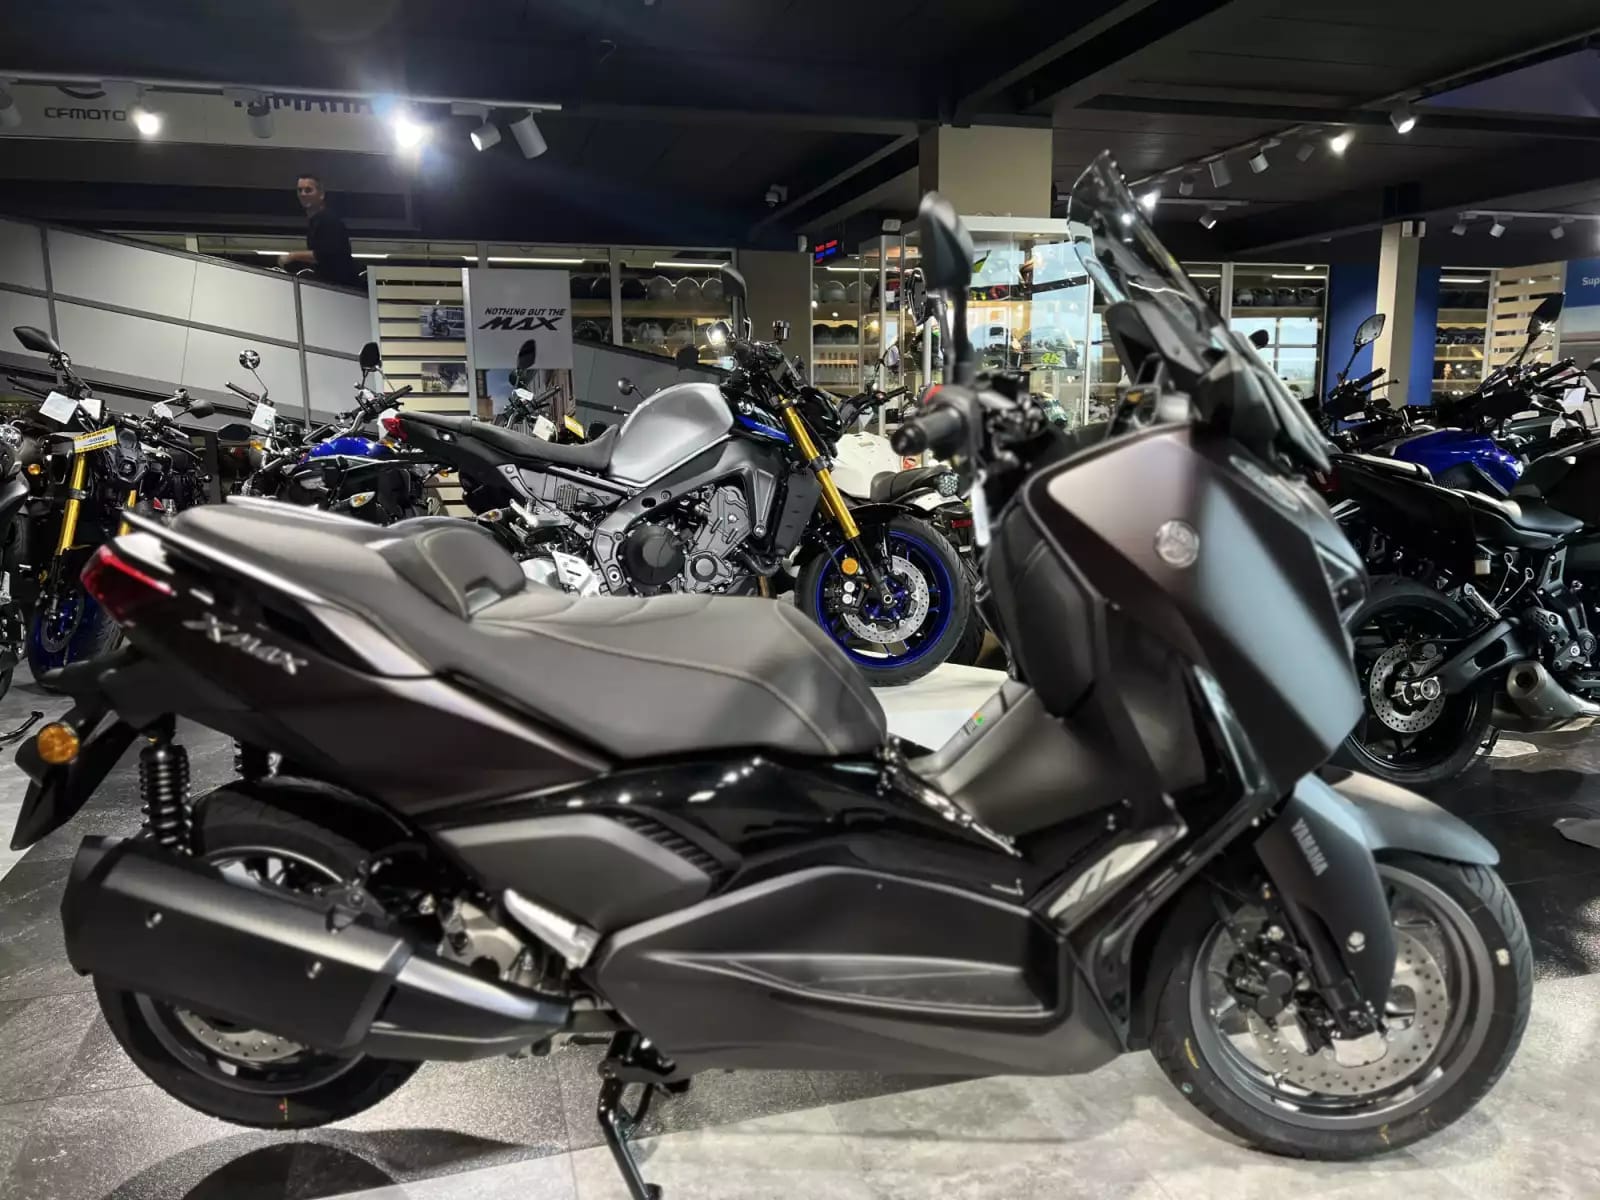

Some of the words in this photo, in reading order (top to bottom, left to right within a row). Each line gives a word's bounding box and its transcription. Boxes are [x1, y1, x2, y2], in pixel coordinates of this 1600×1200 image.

[44, 107, 127, 121] CFMOTO
[485, 307, 527, 316] NOTHING
[527, 308, 546, 316] BUT
[548, 308, 567, 316] THE
[478, 316, 563, 331] MAX
[1291, 817, 1328, 876] YAMAHA
